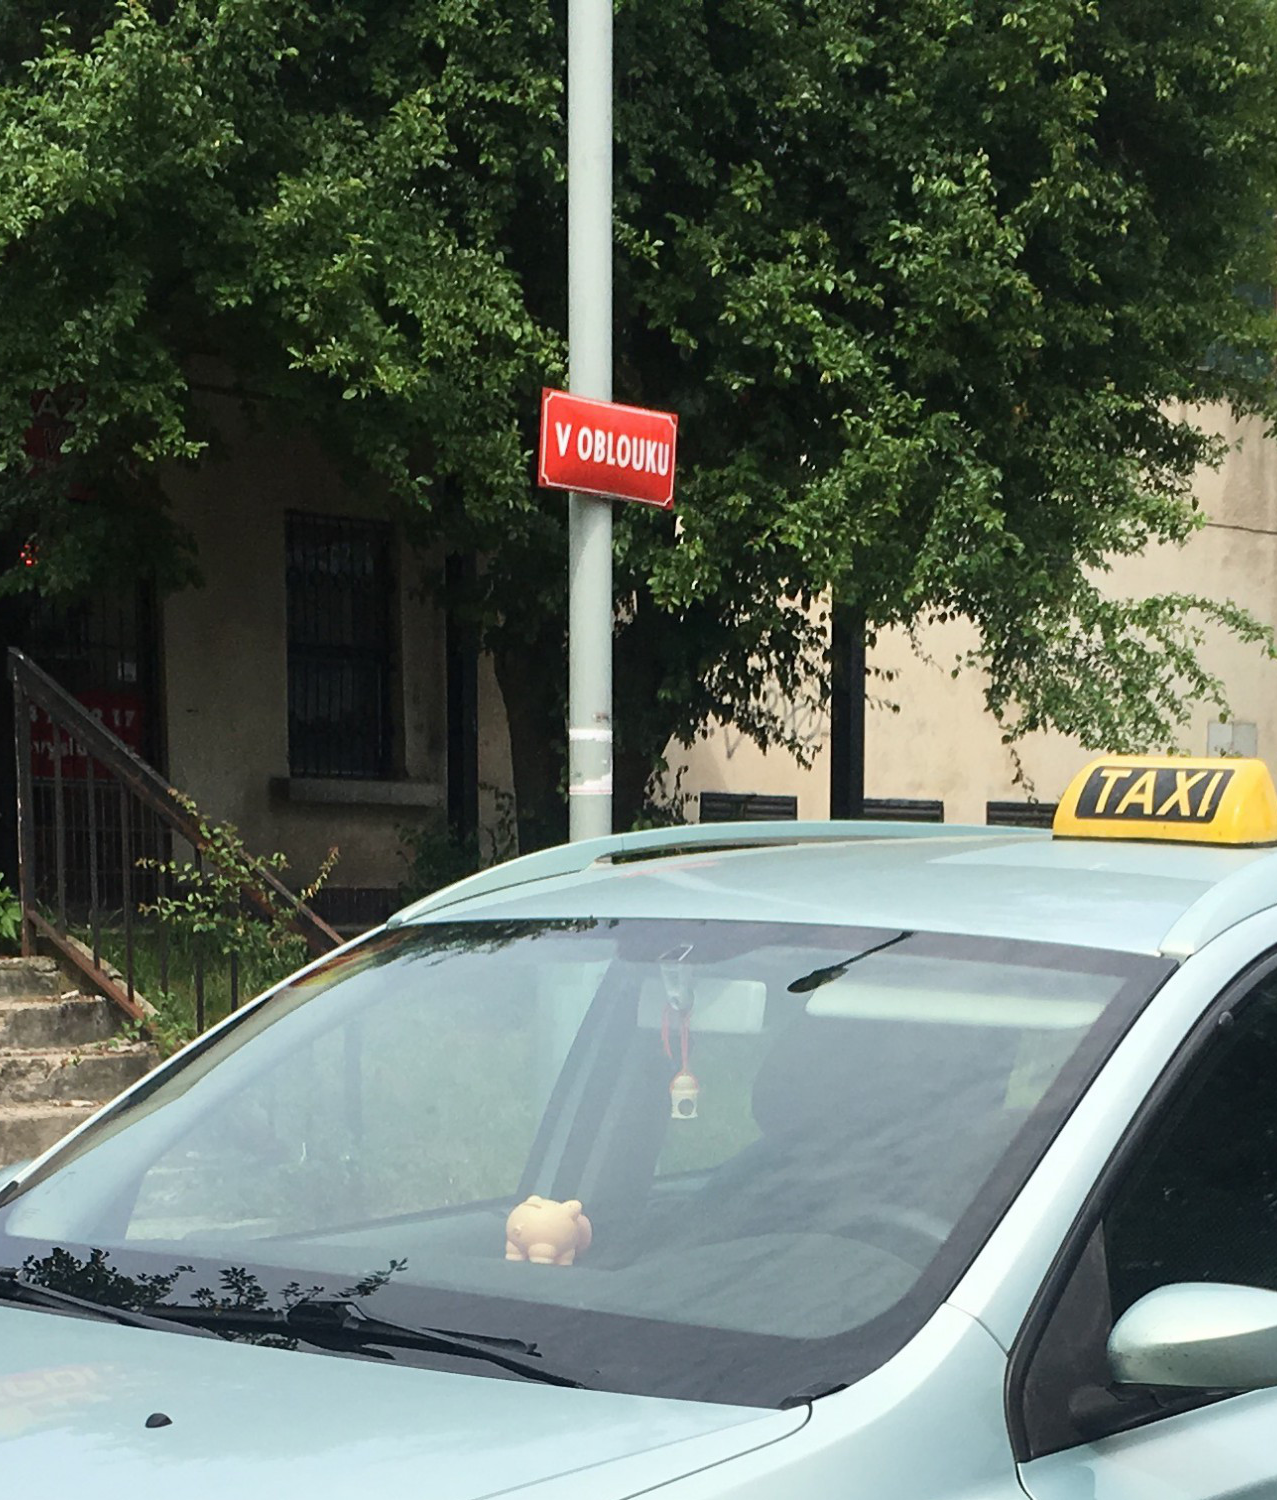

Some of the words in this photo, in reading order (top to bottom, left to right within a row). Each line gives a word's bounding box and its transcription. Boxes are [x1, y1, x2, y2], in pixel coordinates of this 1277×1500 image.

[555, 422, 572, 457] V
[577, 426, 670, 477] OBLOUKU
[1094, 769, 1225, 818] TAXI
